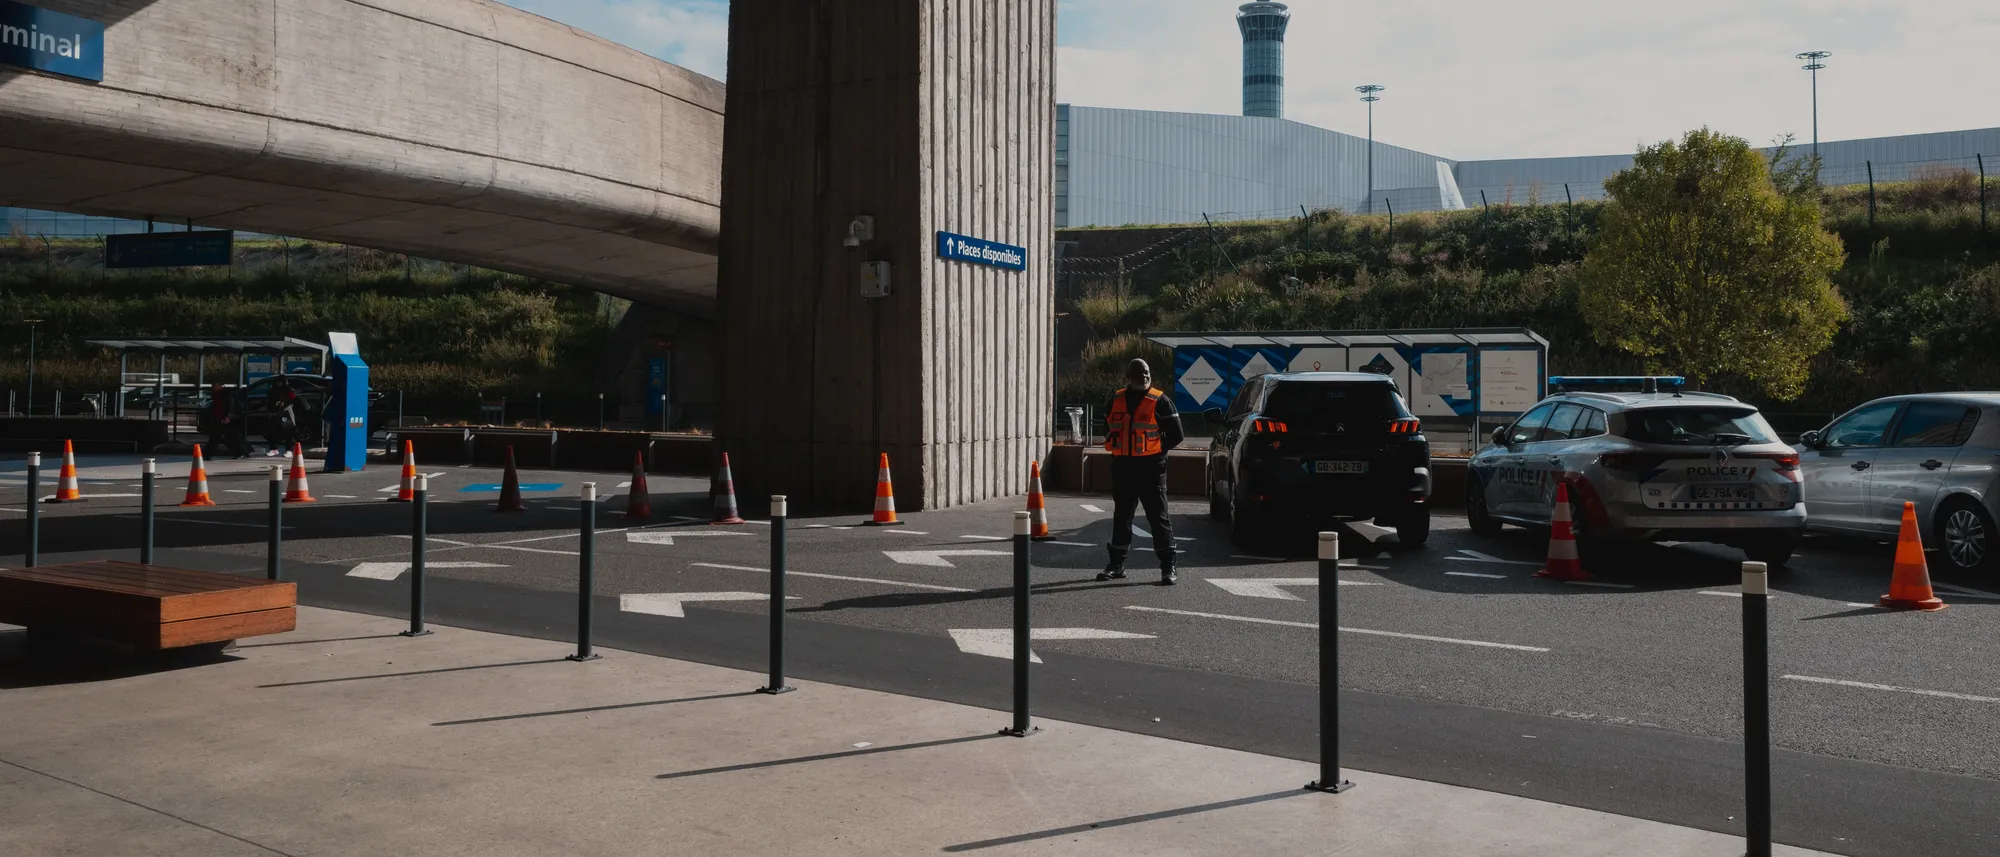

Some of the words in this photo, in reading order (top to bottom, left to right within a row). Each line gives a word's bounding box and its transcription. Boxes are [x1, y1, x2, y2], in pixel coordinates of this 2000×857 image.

[0, 24, 80, 60] minal
[957, 240, 981, 258] Places
[982, 244, 1021, 265] disponibles
[1317, 462, 1362, 472] GB-342-ZB
[1686, 467, 1738, 476] POLICE
[1499, 466, 1534, 486] POLICE
[1696, 487, 1748, 498] GE-794-WG
